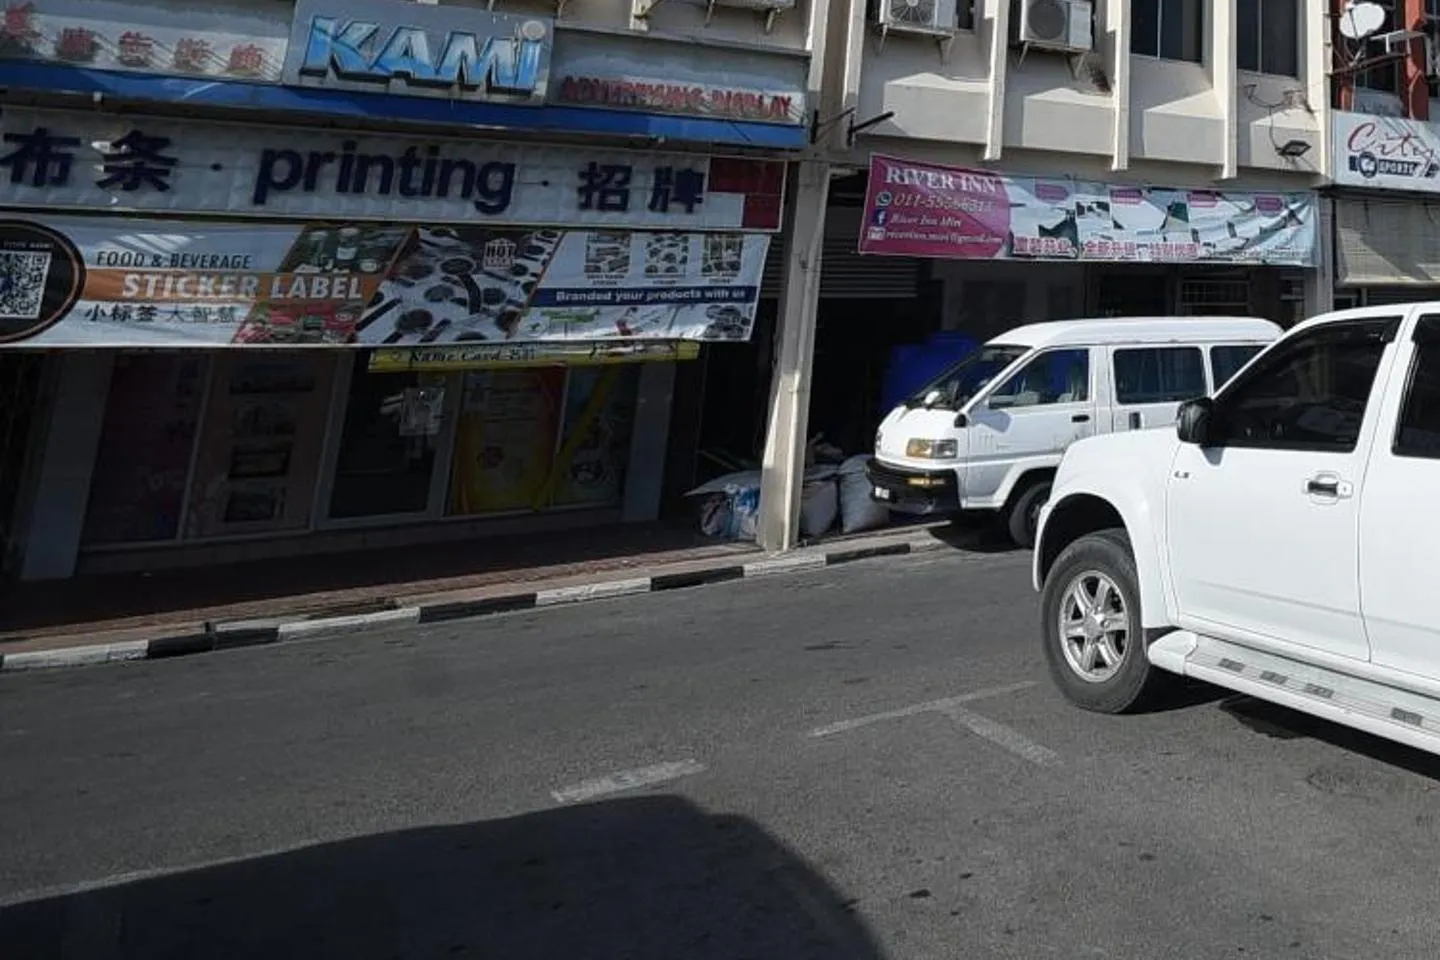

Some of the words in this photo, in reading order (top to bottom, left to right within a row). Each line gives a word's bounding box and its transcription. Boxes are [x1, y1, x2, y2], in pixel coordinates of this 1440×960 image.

[253, 141, 516, 215] printing
[577, 161, 704, 213] 招牌
[885, 166, 955, 190] RIVER
[961, 174, 997, 193] INN
[97, 251, 146, 266] FOOD
[151, 255, 163, 267] &
[169, 252, 253, 270] BEVERAGE
[122, 272, 258, 299] STICKER
[269, 274, 363, 300] LABEL
[556, 291, 612, 301] Branded
[616, 292, 643, 303] your
[647, 290, 701, 303] products
[704, 289, 729, 299] with
